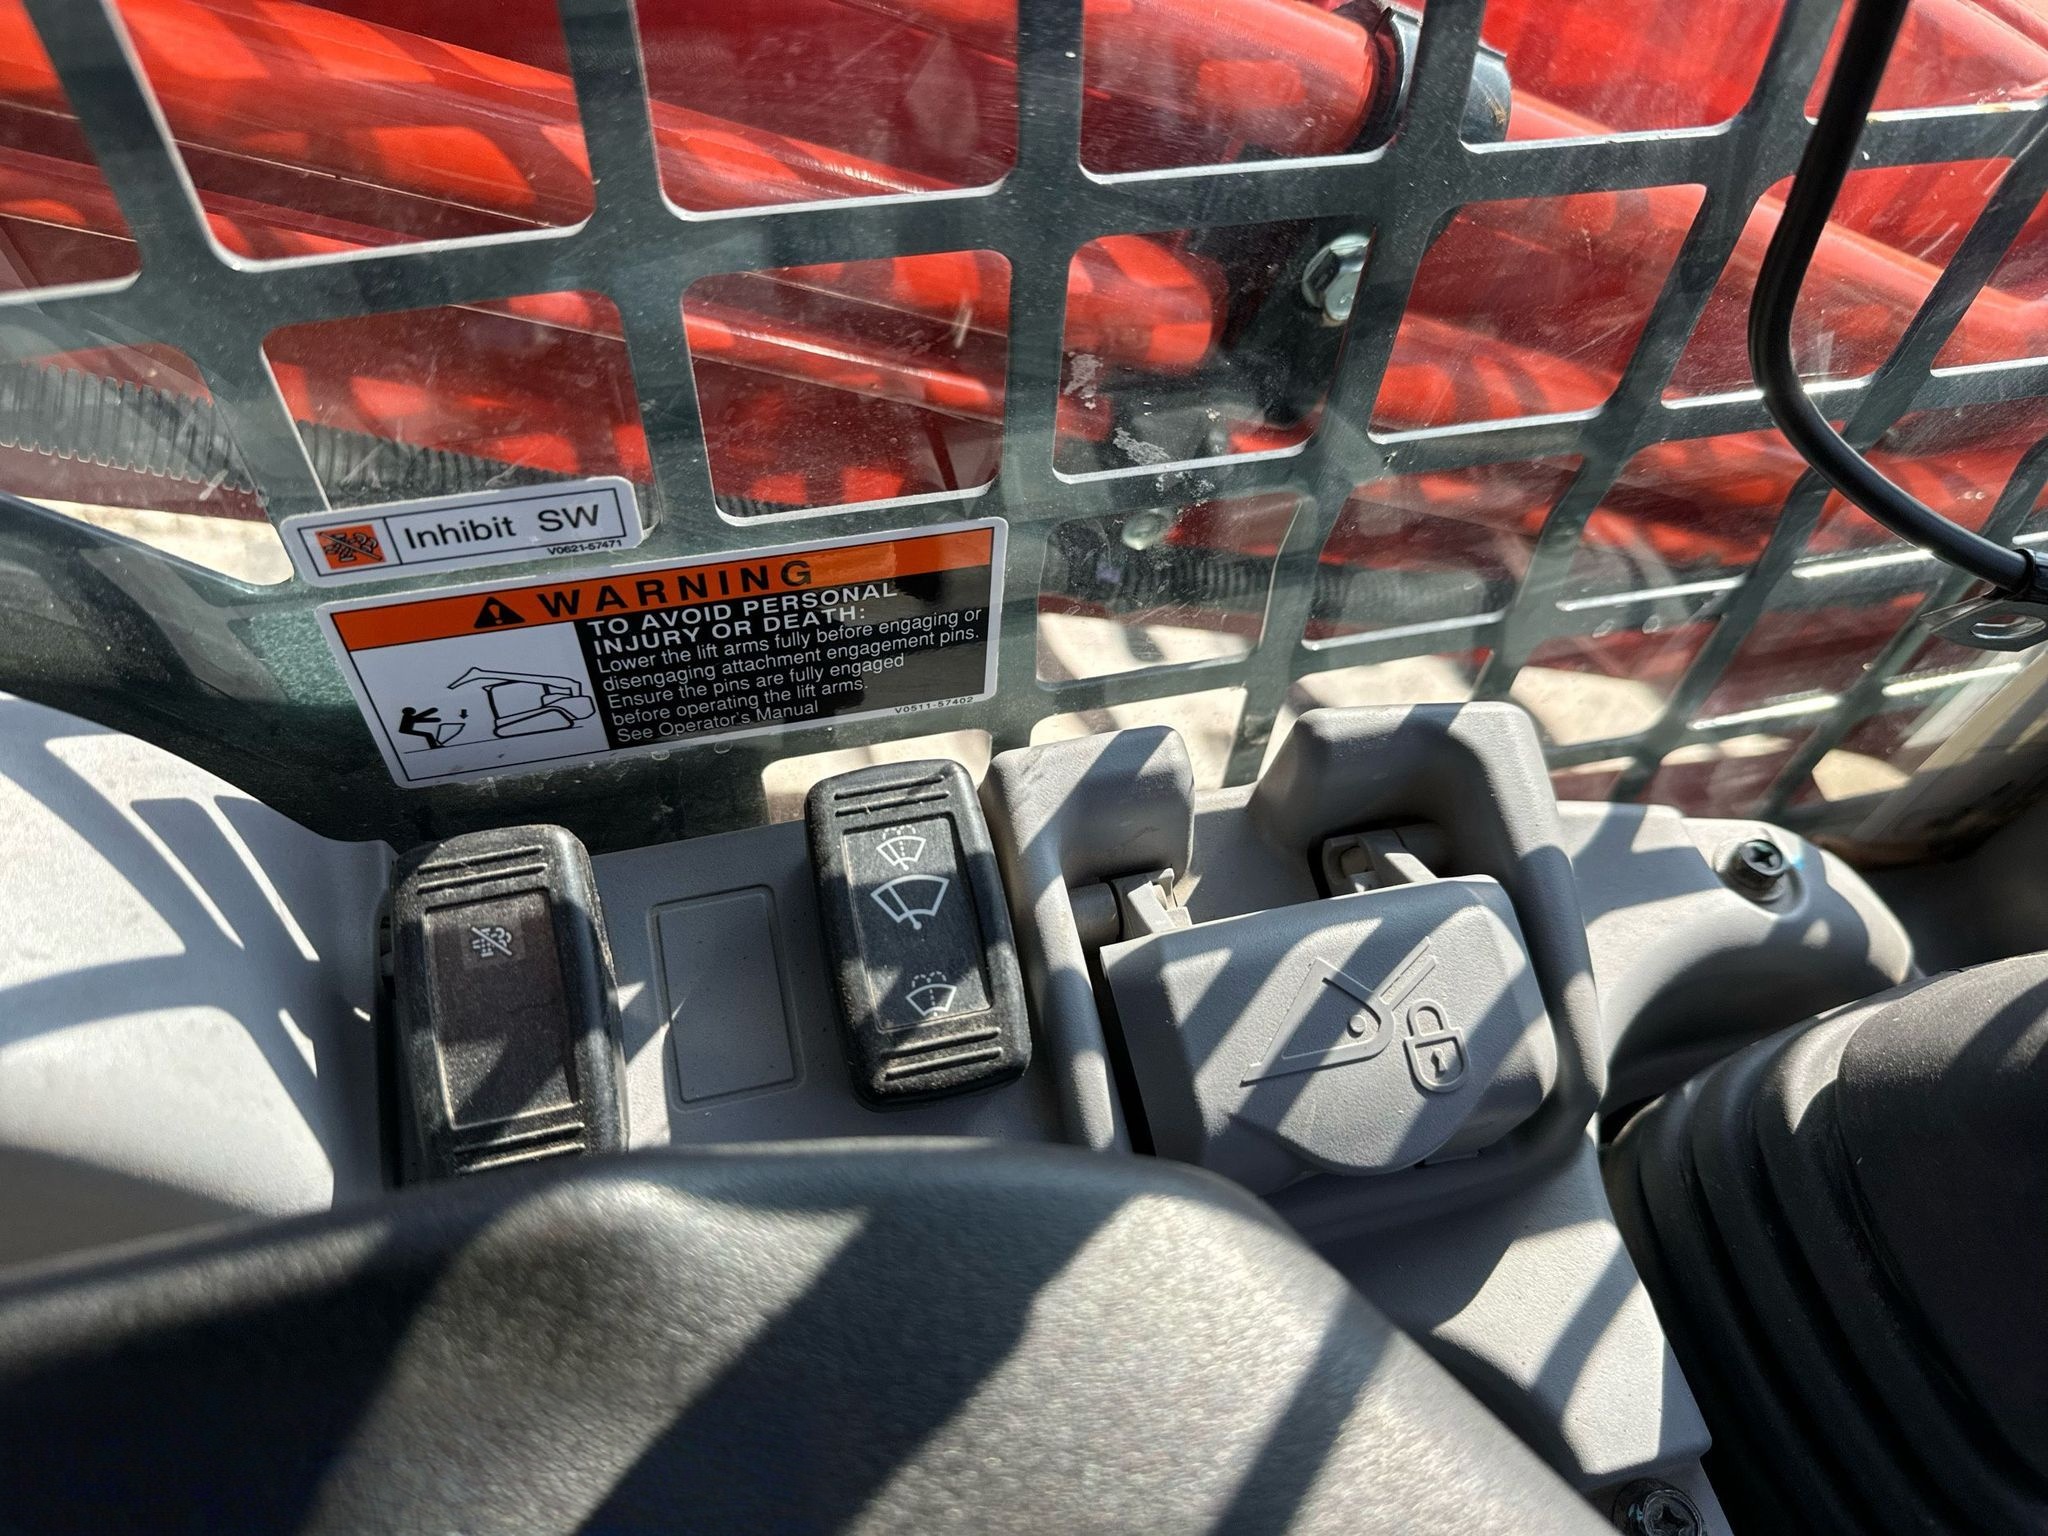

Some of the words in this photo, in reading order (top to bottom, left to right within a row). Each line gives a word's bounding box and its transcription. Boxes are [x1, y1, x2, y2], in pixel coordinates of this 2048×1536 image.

[404, 516, 516, 549] Inhibit
[537, 504, 599, 533] SW
[536, 560, 812, 618] WARNING
[587, 618, 629, 636] TO
[641, 604, 732, 631] AVOID
[743, 582, 898, 616] PERSONAL
[593, 627, 701, 656] INJURY
[712, 621, 752, 639] OR
[763, 605, 865, 632] DEATH:
[597, 654, 656, 673] Lower
[661, 649, 692, 665] the
[696, 643, 718, 660] lift
[724, 638, 769, 656] arms
[775, 631, 811, 649] fully
[816, 624, 873, 643] before
[879, 612, 958, 635] engaging
[964, 608, 982, 622] or
[602, 665, 717, 691] disengaging
[722, 649, 822, 675] attachment
[826, 632, 935, 659] engagement
[940, 628, 980, 647] pins.
[607, 689, 674, 709] Ensure
[678, 683, 708, 699] the
[713, 677, 750, 697] pins
[756, 672, 784, 688] are
[789, 666, 824, 683] fully
[830, 652, 904, 677] engaged
[612, 707, 671, 726] before
[676, 693, 759, 718] operating
[764, 688, 791, 704] the
[796, 682, 816, 698] lift
[821, 678, 868, 695] arms.
[617, 727, 653, 742] See
[658, 711, 750, 736] Operator's
[756, 701, 819, 721] Manual
[894, 696, 974, 714] V0511-57402
